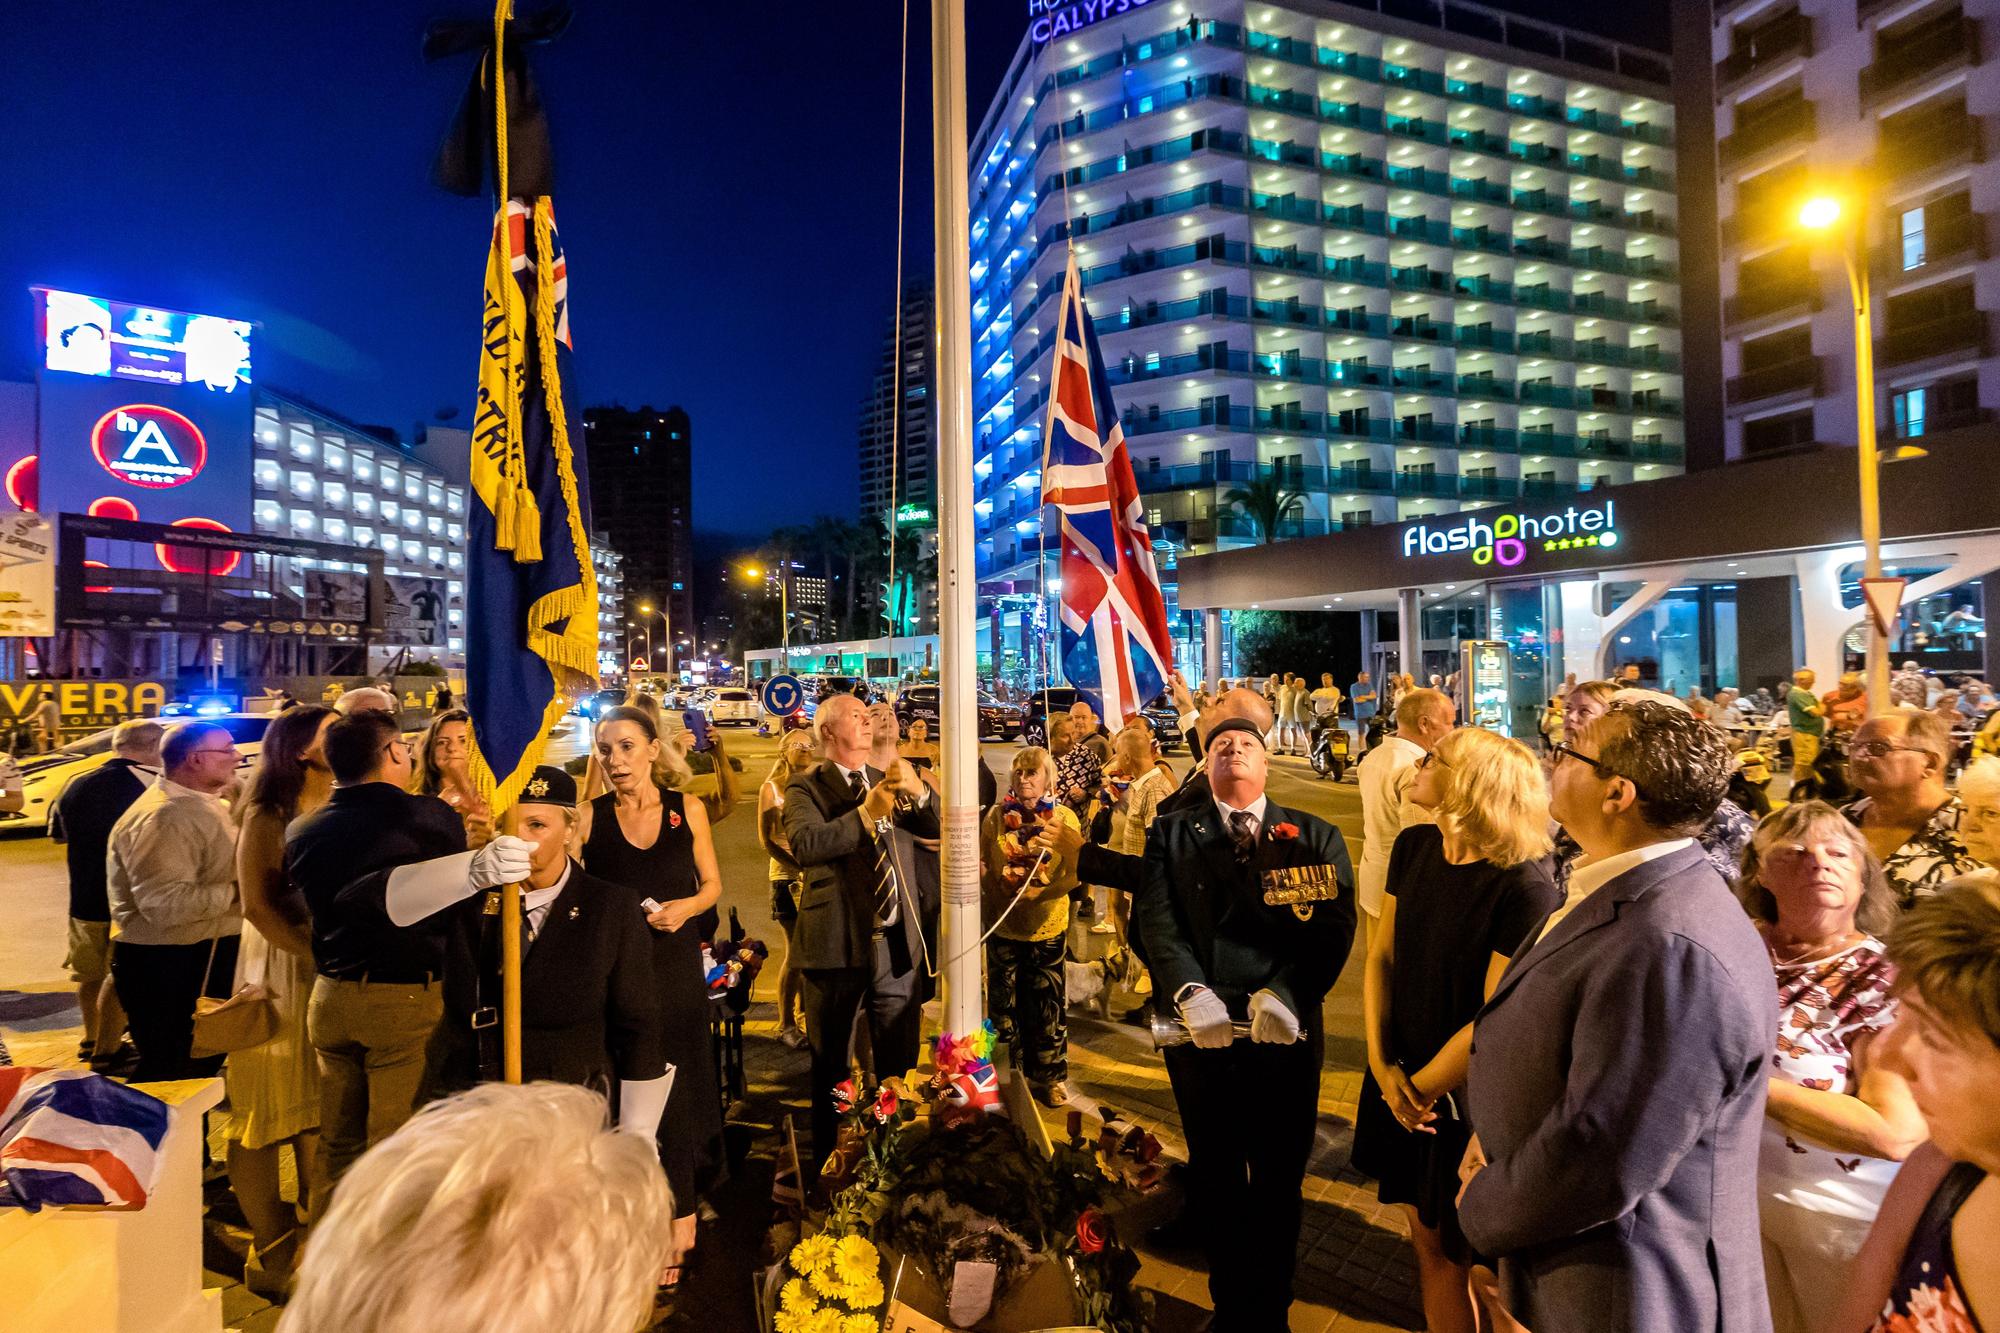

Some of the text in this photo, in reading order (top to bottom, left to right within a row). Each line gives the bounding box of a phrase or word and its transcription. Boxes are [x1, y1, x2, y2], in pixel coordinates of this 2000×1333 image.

[1404, 500, 1614, 557] flash hotel
[0, 682, 166, 717] VERA
